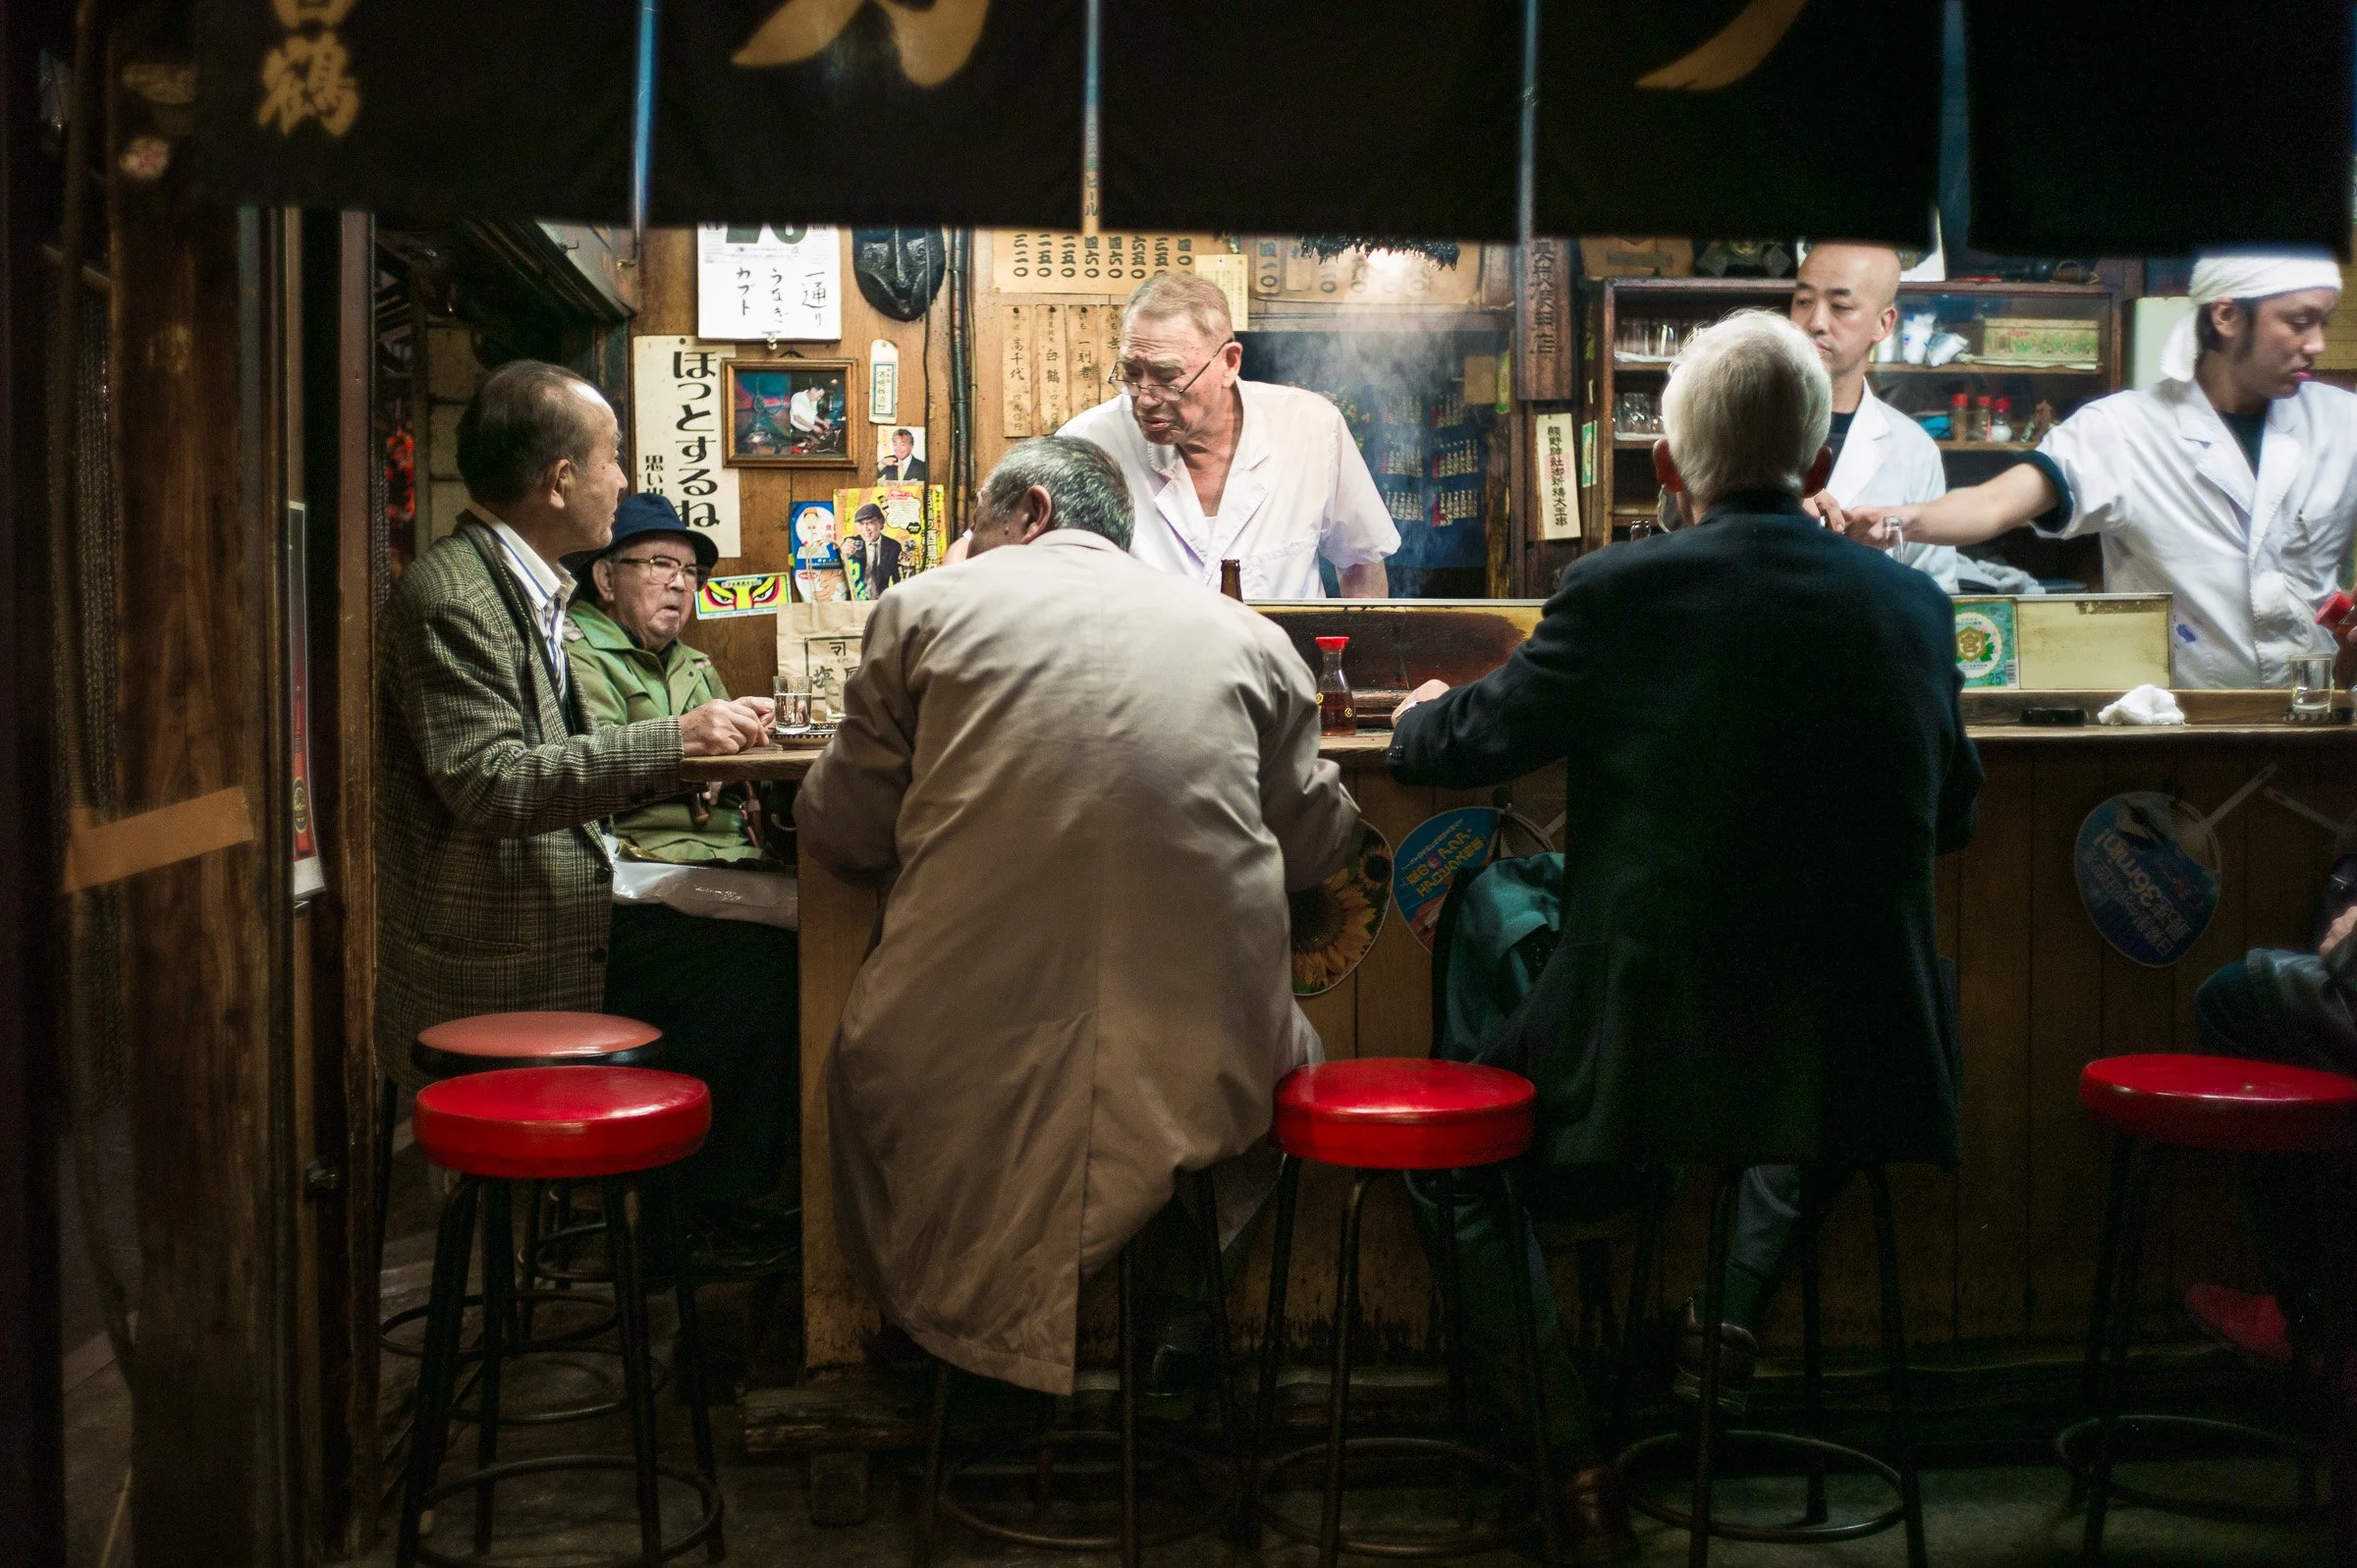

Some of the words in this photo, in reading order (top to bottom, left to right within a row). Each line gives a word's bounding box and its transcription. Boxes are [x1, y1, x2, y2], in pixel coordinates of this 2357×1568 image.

[673, 351, 721, 528] ほっとするね
